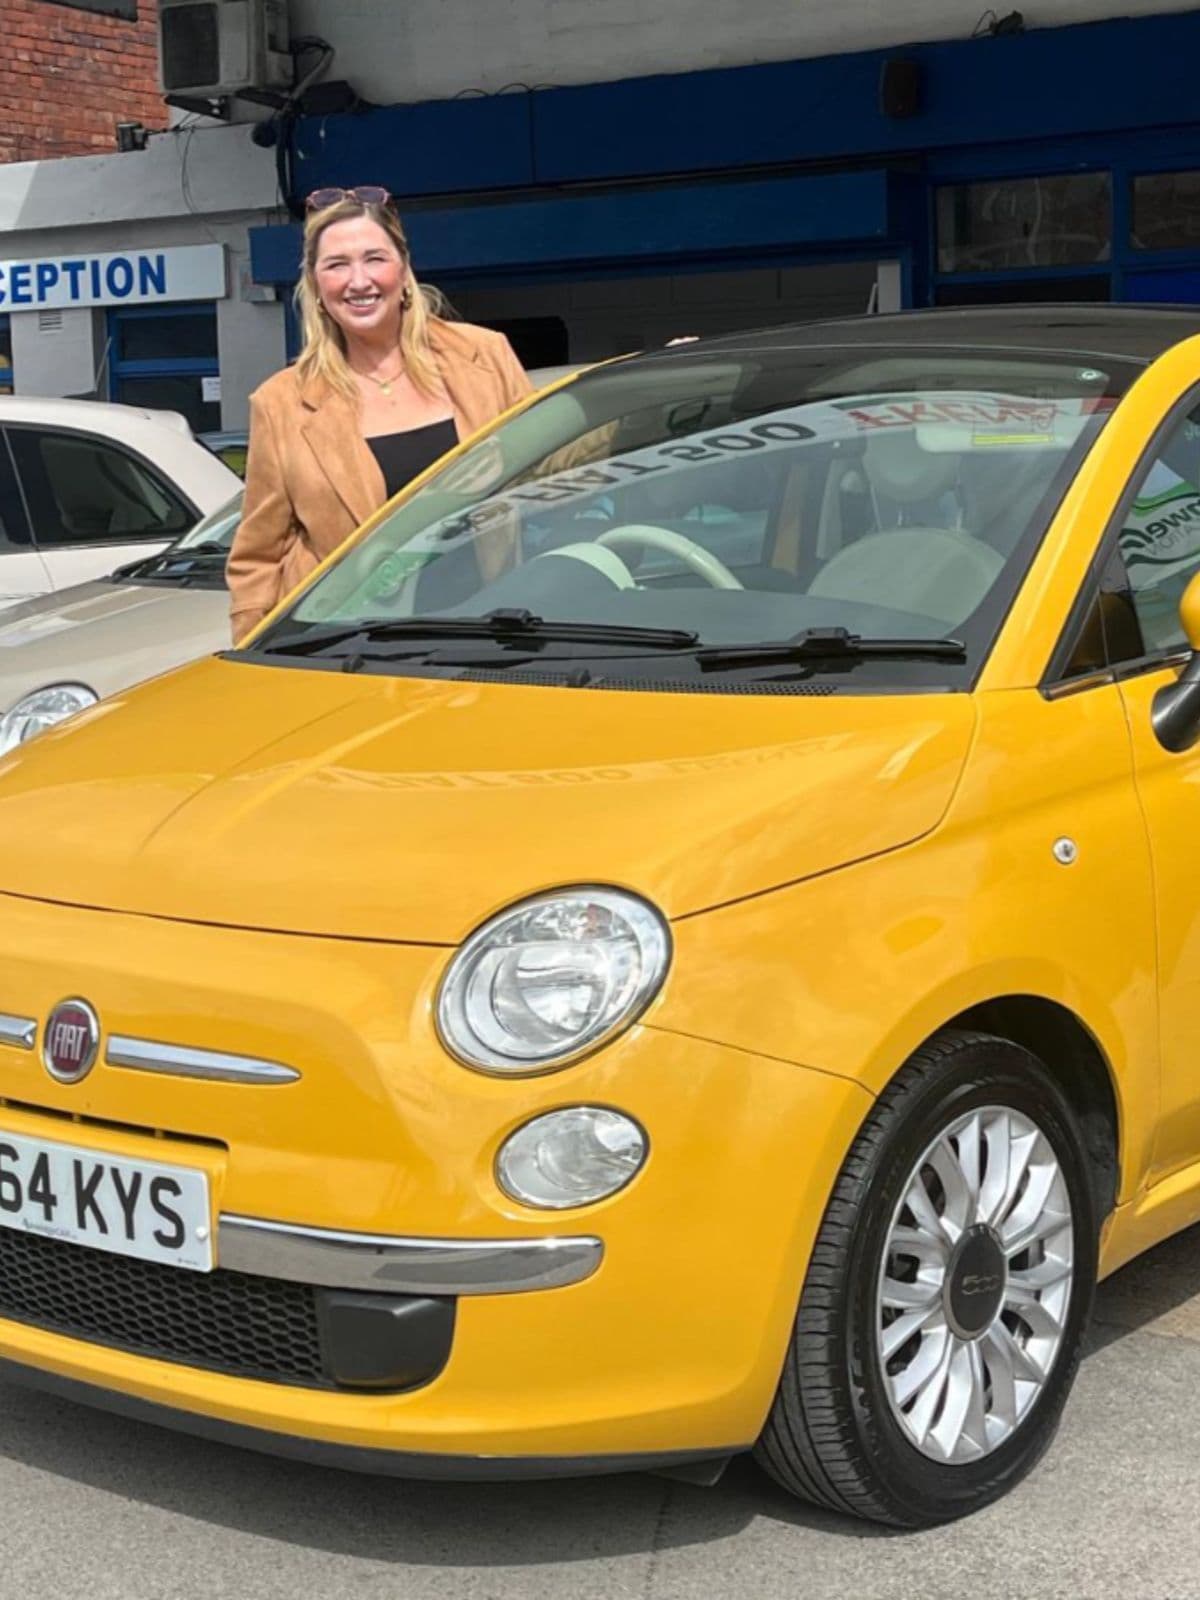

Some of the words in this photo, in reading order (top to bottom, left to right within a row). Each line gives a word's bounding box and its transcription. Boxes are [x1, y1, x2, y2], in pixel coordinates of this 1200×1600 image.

[0, 254, 167, 305] EPTION
[54, 1023, 87, 1061] FIAT
[0, 1142, 58, 1222] 64
[73, 1159, 186, 1250] KYS
